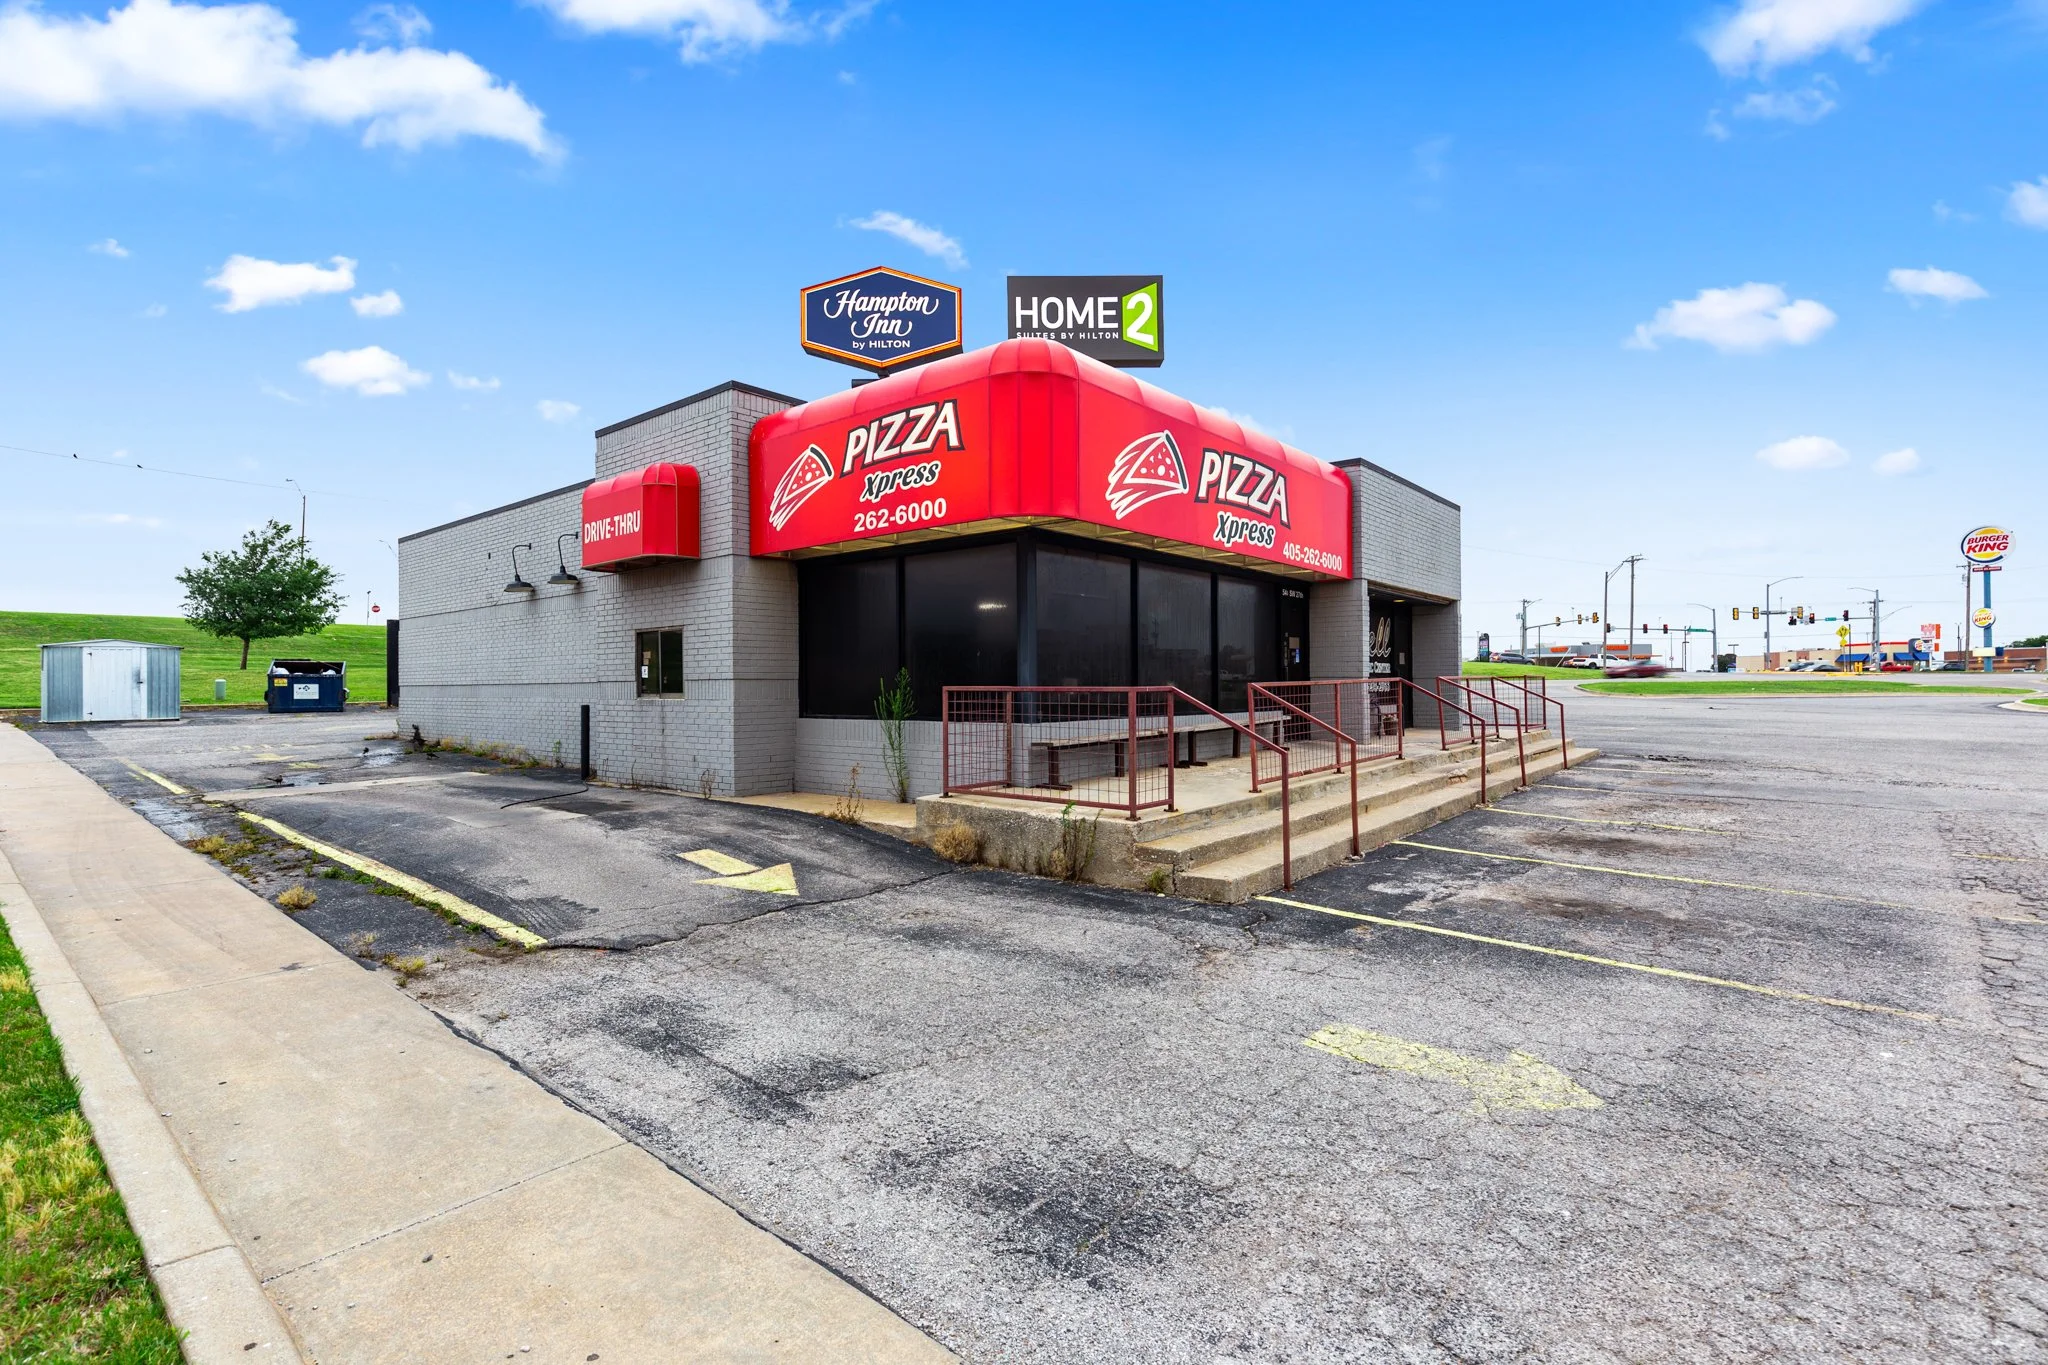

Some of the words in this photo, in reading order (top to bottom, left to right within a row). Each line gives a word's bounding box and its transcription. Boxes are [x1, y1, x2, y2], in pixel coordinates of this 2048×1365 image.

[824, 289, 939, 319] Hampton
[1015, 296, 1119, 329] HOME
[1126, 292, 1154, 346] 2
[851, 313, 913, 339] Inn
[1016, 332, 1056, 340] SUITES
[1060, 332, 1074, 340] BY
[1079, 332, 1119, 340] HILTON
[853, 341, 865, 350] by
[869, 340, 911, 349] HILTON
[839, 399, 966, 479] PIZZA
[859, 460, 942, 504] Xpress
[1194, 447, 1291, 530] PIZZA
[584, 509, 641, 544] DRIVE-THRU
[853, 497, 947, 533] 262-6000
[1213, 511, 1276, 550] Xpress
[1282, 541, 1343, 572] 405-262-6000
[1966, 541, 2009, 554] KING
[1967, 535, 2009, 545] BURGER
